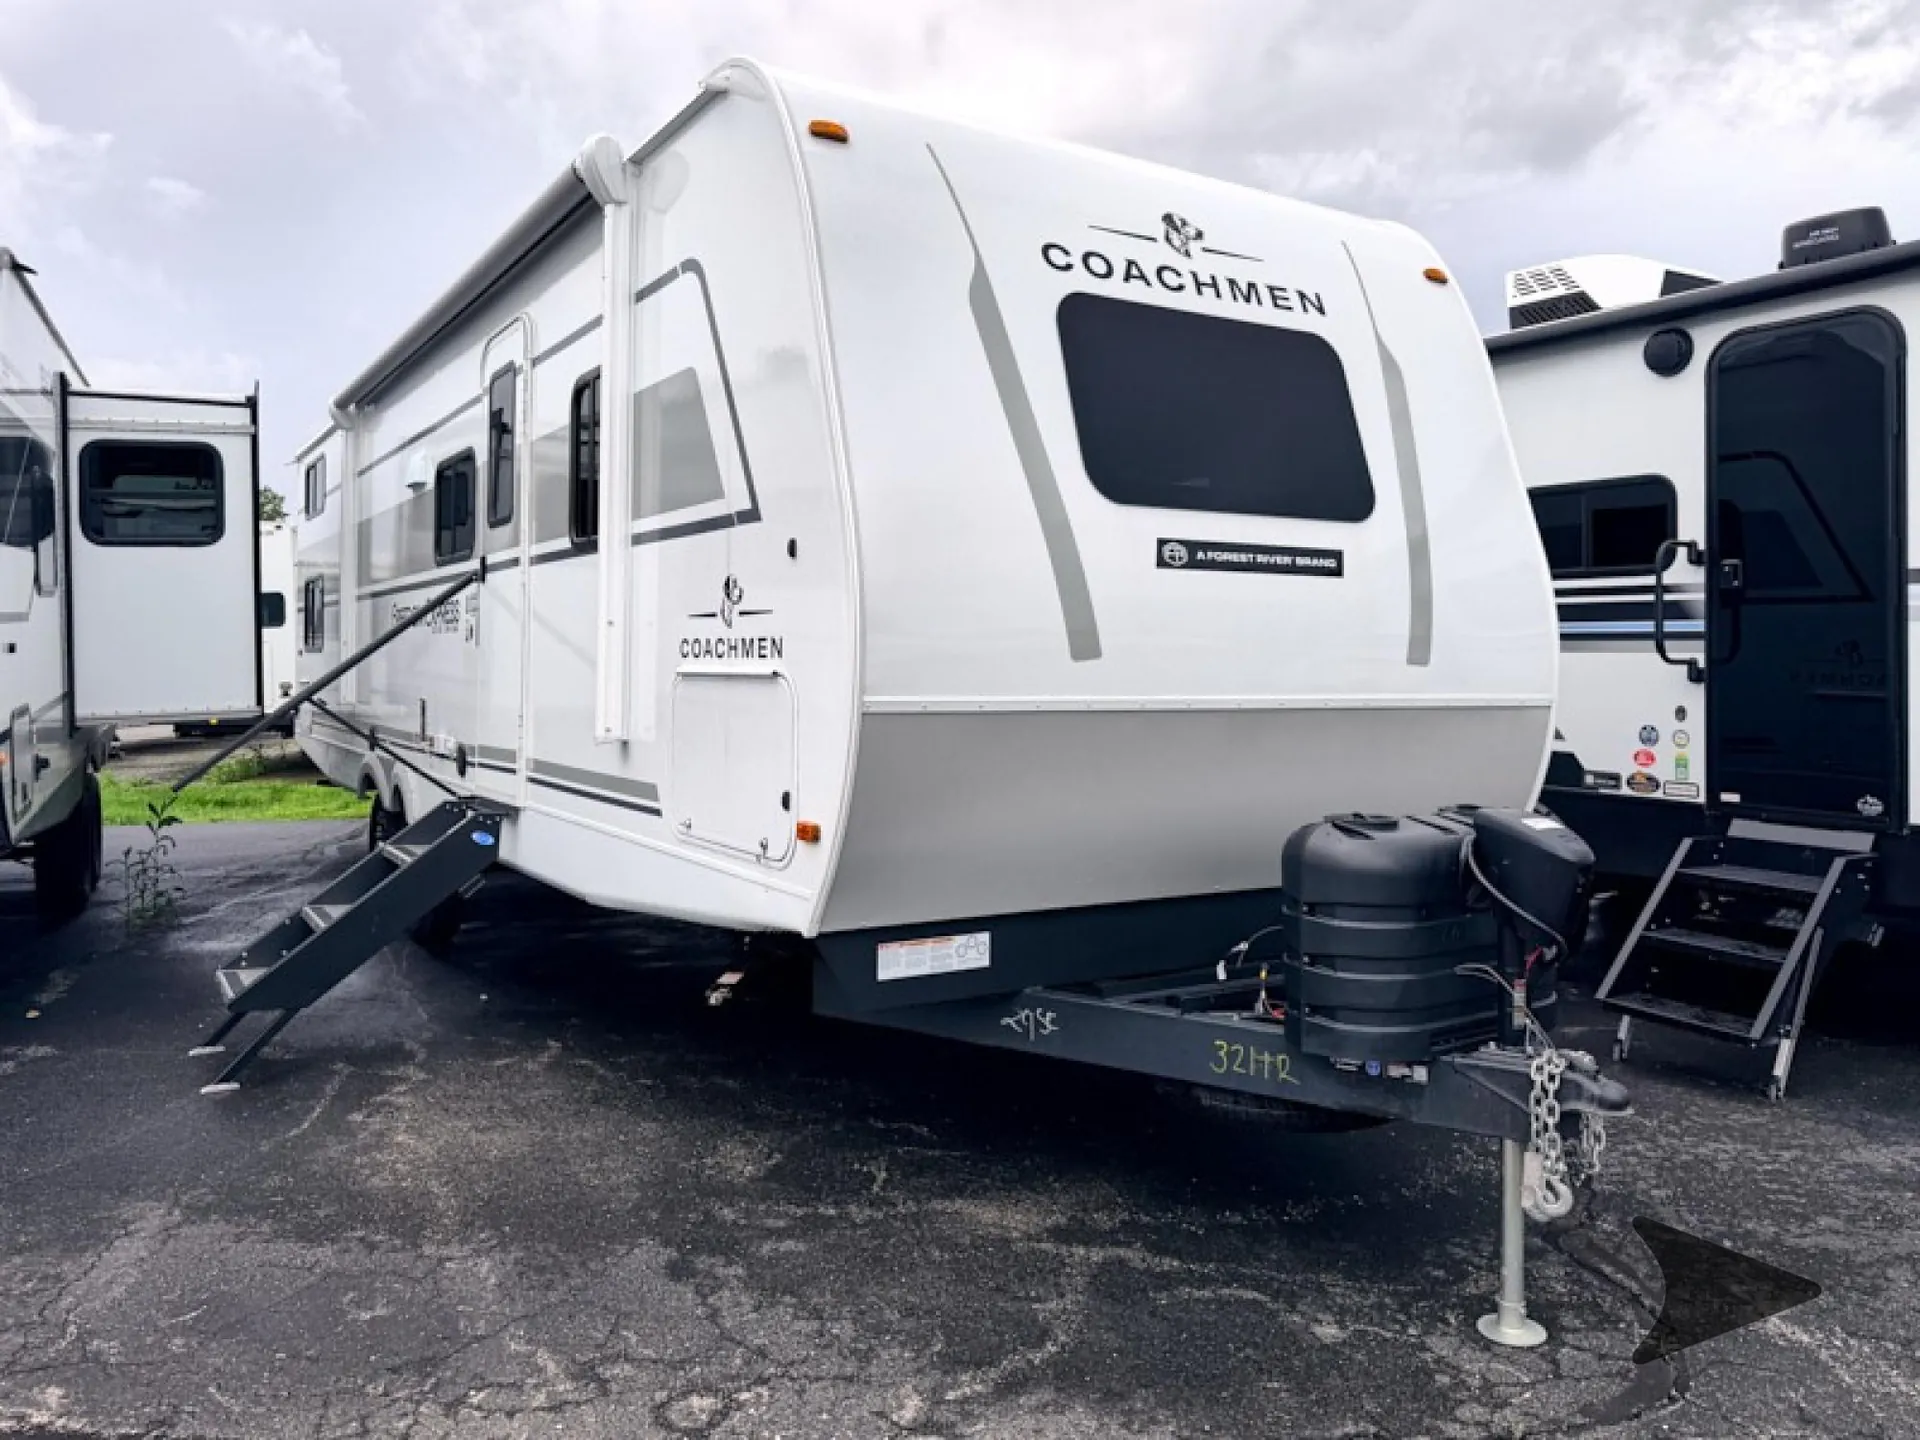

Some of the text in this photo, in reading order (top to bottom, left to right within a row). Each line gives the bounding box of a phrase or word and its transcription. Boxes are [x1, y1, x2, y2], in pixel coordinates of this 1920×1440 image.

[1041, 241, 1327, 317] COACHMEN
[1207, 551, 1254, 563] FOREST
[1257, 554, 1293, 567] RIVER
[1295, 556, 1338, 569] BRAND
[679, 636, 784, 659] COACHMEN
